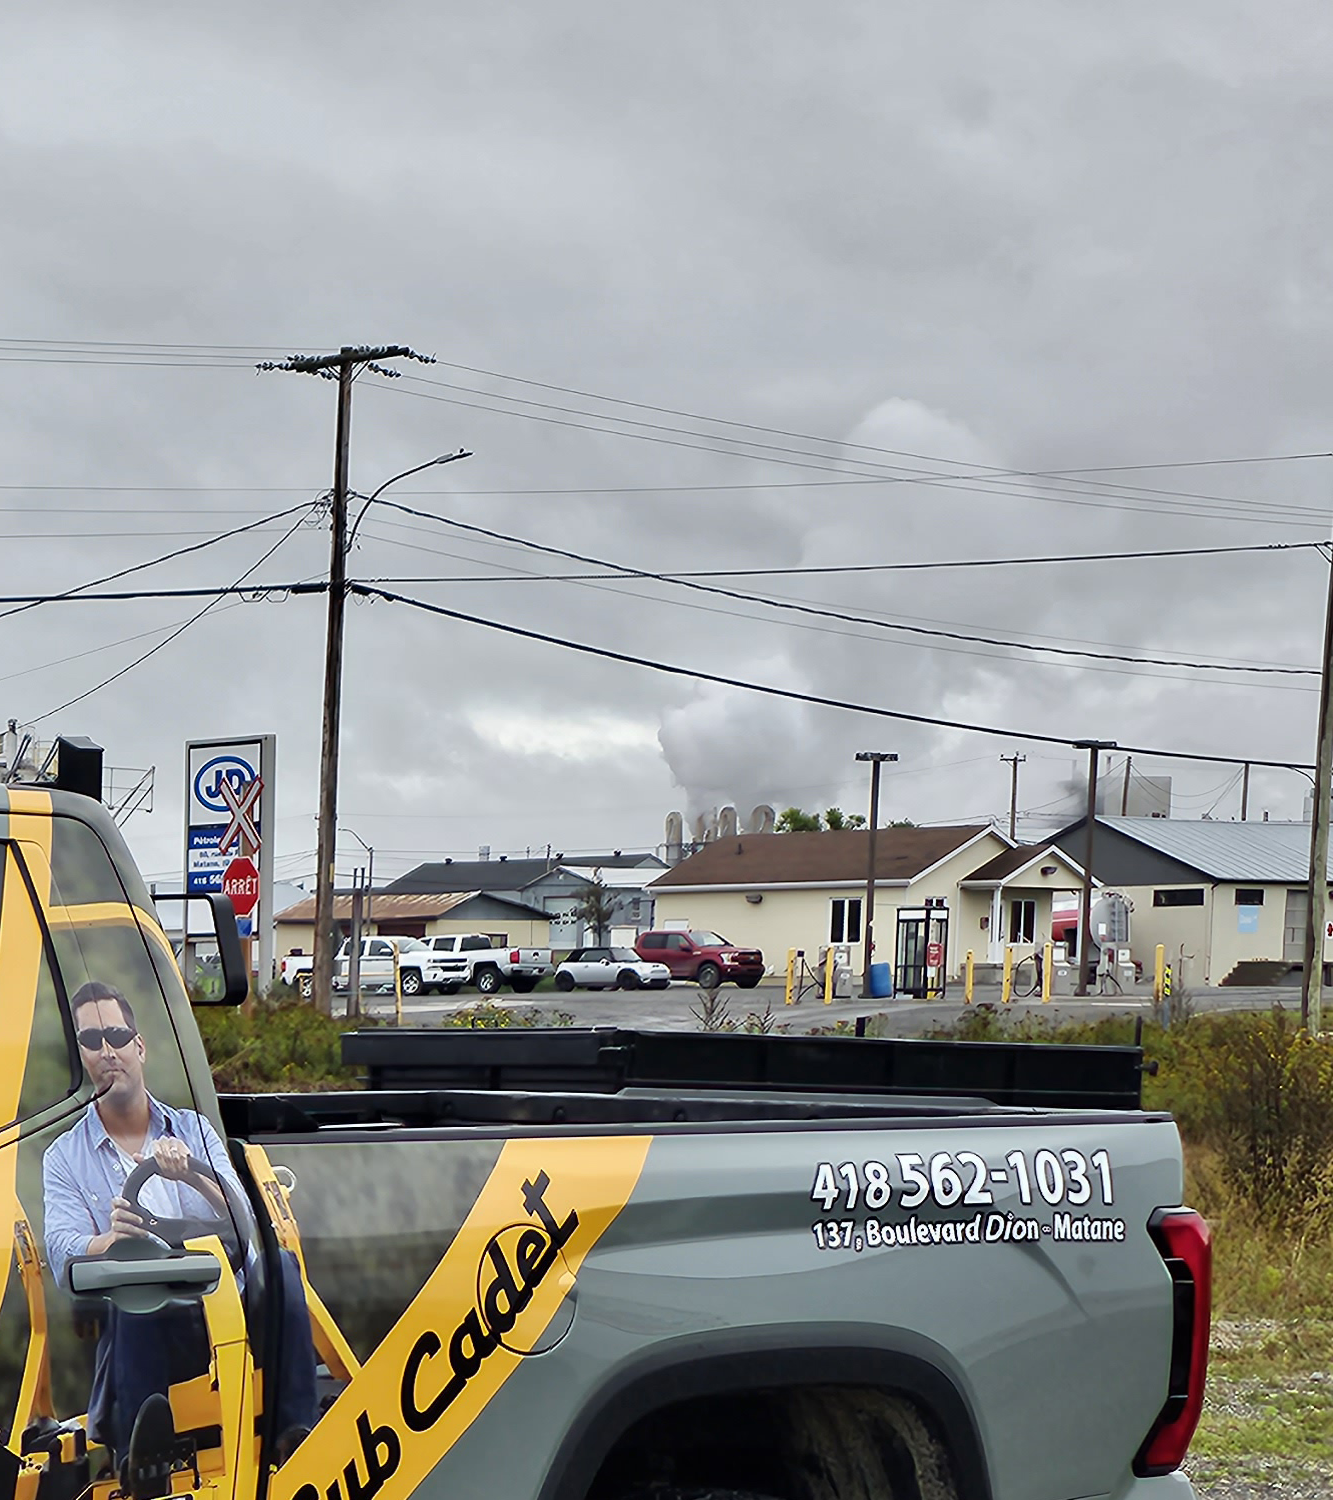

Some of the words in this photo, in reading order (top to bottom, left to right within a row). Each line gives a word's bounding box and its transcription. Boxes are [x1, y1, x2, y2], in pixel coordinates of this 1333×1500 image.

[193, 836, 221, 845] Pétrole
[223, 875, 257, 895] ARRÊT
[811, 1161, 893, 1211] 418
[894, 1149, 1115, 1209] 562-1031
[812, 1219, 864, 1252] 137,
[865, 1214, 982, 1248] Boulevard
[985, 1211, 1040, 1242] Dion
[1052, 1213, 1126, 1242] Matane
[400, 1169, 581, 1433] Cadet
